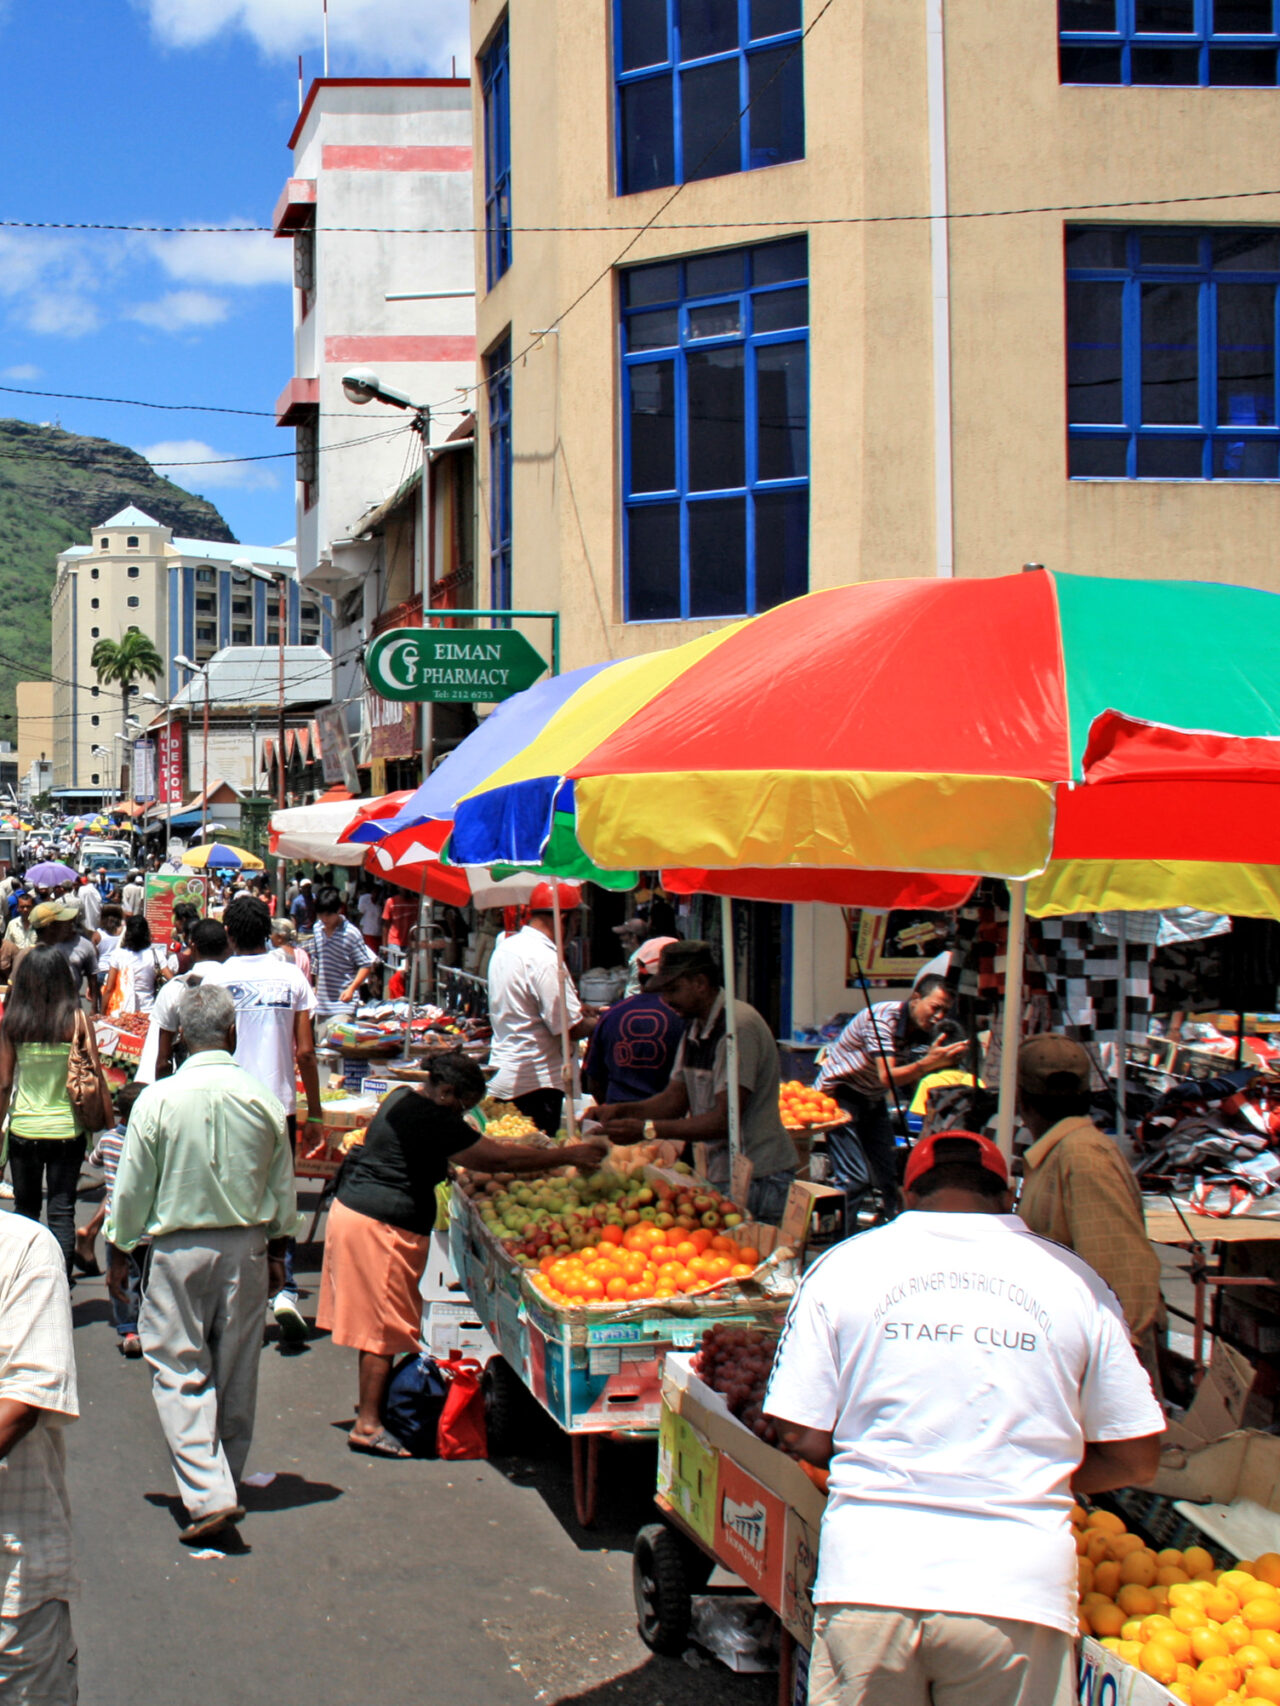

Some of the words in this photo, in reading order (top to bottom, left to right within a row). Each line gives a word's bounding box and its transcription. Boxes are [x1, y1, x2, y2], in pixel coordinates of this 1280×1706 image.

[434, 643, 502, 660] EIMAN
[423, 668, 509, 685] PHARMACY
[433, 690, 449, 698] Tel:
[170, 739, 180, 799] DECOR
[873, 1282, 908, 1326] BLACK
[909, 1271, 945, 1294] RIVER
[949, 1271, 1005, 1296] DISTRICT
[1007, 1284, 1054, 1341] COUNCIL
[884, 1322, 963, 1342] STAFF
[974, 1326, 1036, 1351] CLUB
